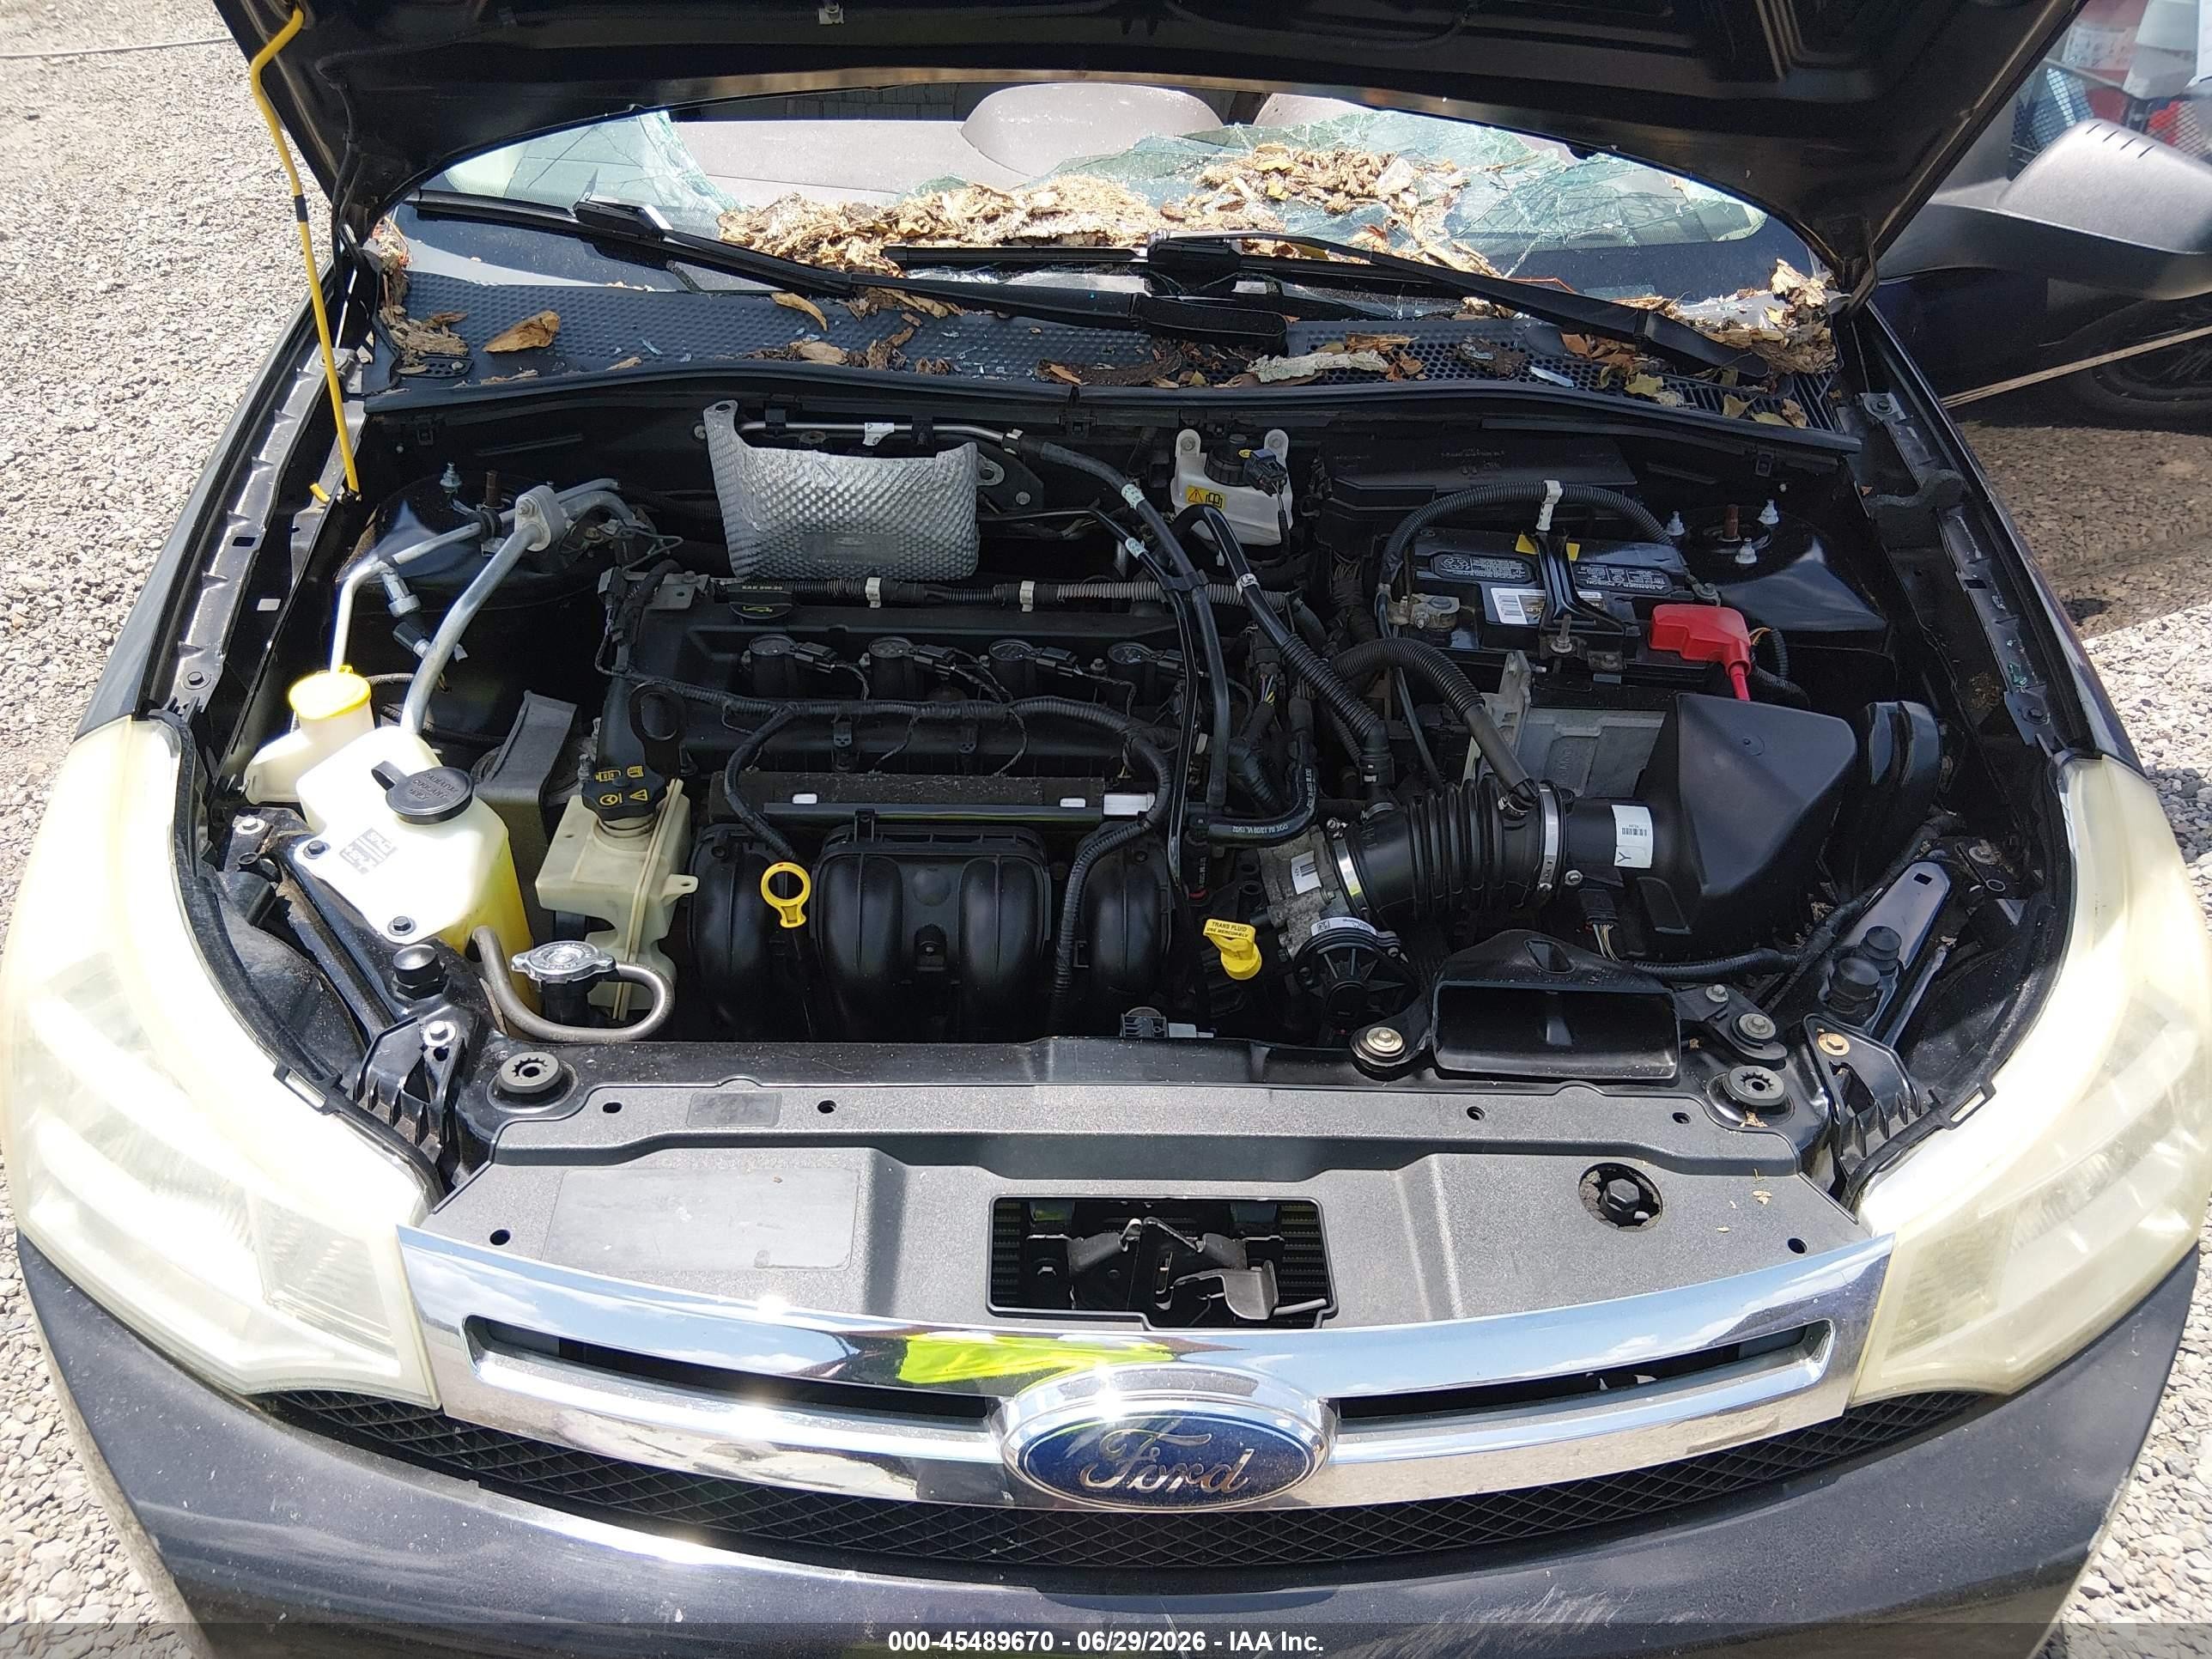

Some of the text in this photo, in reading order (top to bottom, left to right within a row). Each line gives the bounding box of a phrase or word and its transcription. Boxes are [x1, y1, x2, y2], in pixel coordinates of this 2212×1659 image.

[1212, 921, 1248, 933] TRANS FLUID
[1079, 1428, 1255, 1494] Ford
